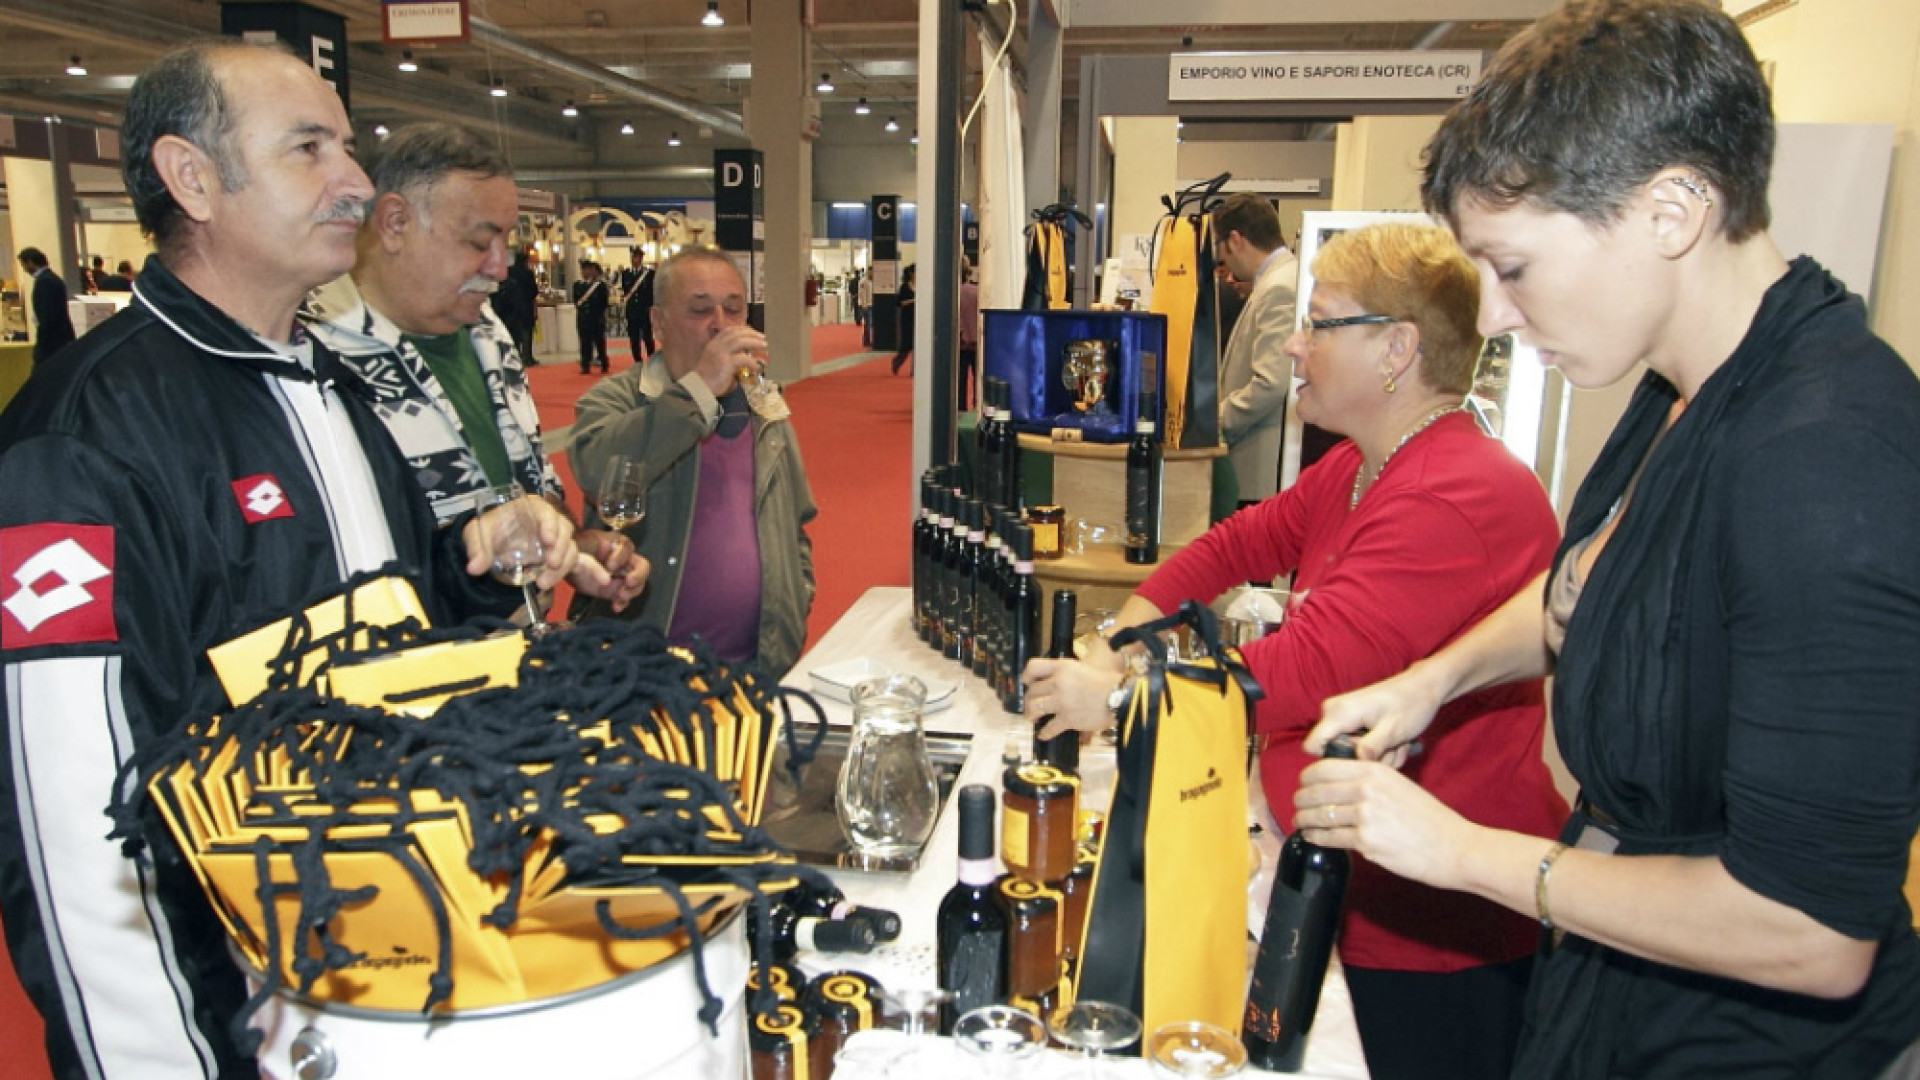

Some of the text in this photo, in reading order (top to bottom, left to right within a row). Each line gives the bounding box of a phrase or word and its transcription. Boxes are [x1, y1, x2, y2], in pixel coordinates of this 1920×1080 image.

[311, 35, 337, 92] E
[1180, 65, 1471, 79] EMPORIO VINO E SAPORI ENOTECA (CR)
[723, 162, 744, 187] D
[877, 203, 892, 220] C
